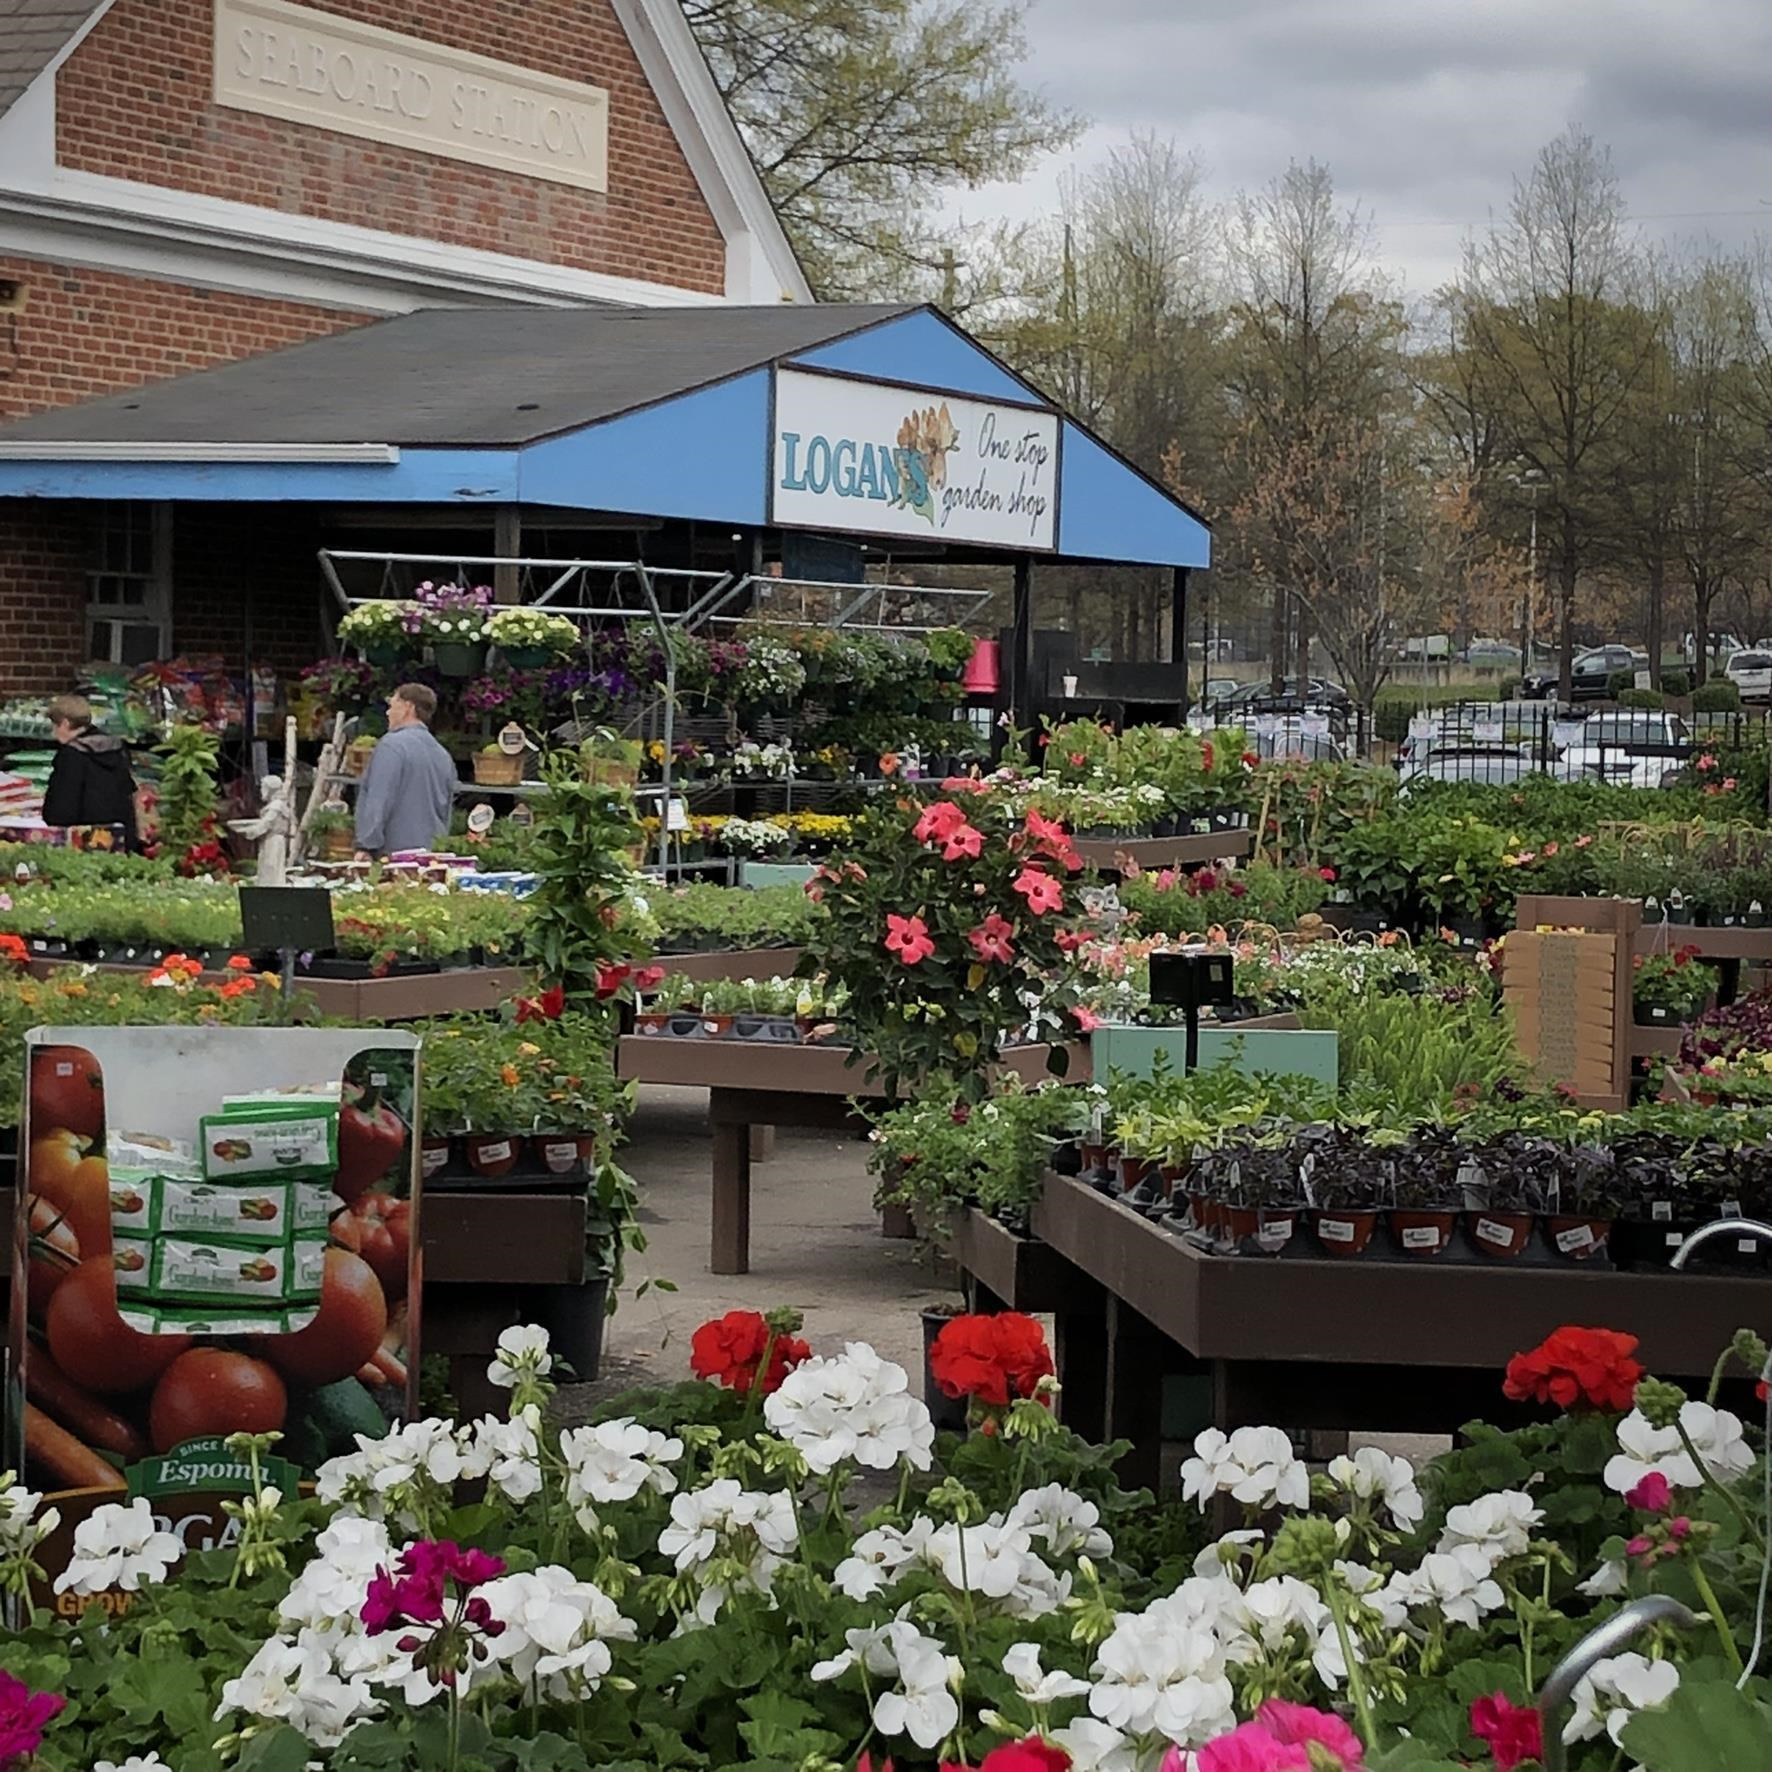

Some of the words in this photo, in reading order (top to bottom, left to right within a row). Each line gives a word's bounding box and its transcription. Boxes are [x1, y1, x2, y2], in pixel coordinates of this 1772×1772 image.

[236, 27, 432, 121] SEABOARD
[451, 82, 587, 160] STATION
[978, 411, 1011, 460] One
[1014, 429, 1049, 487] stop
[941, 467, 1002, 528] garden
[1007, 471, 1048, 537] shop
[180, 1440, 219, 1457] SINCE
